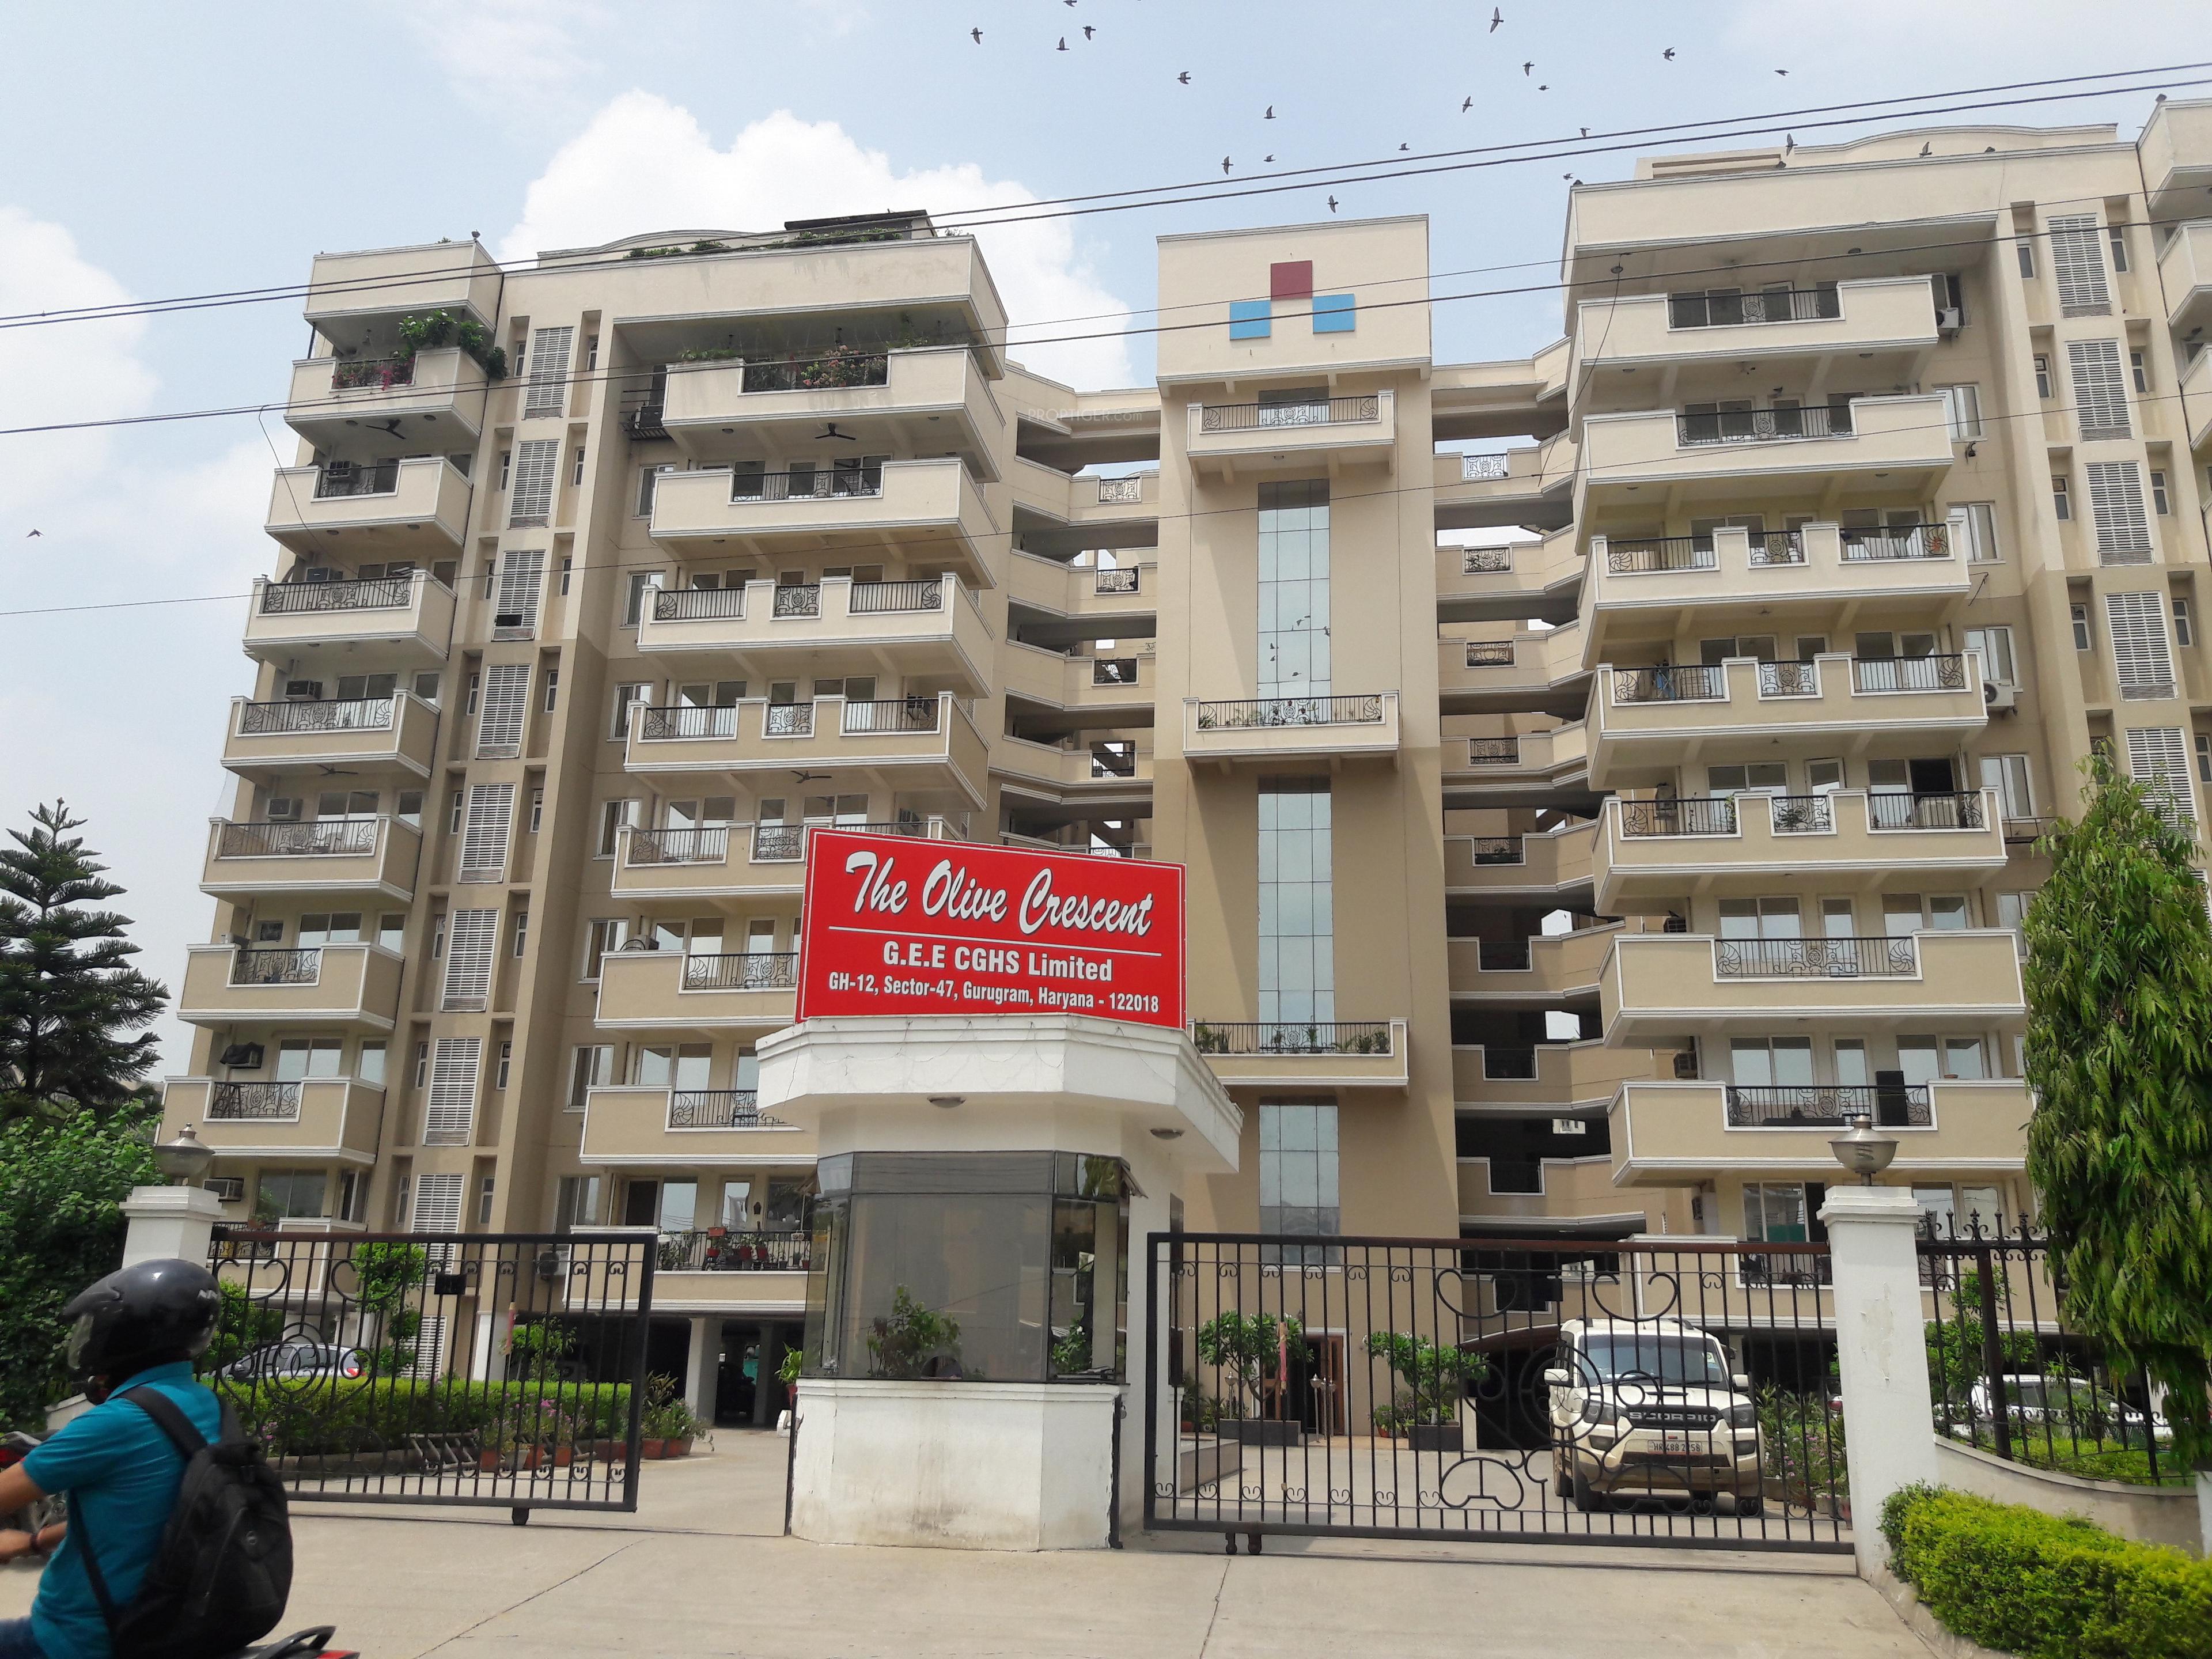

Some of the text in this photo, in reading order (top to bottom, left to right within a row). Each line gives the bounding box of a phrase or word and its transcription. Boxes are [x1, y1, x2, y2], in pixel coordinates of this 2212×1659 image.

[845, 851, 1153, 935] The Olive Crescent
[883, 941, 1113, 982] G.E.E CGHS Limited
[829, 971, 879, 995] GH-12,
[884, 975, 959, 1001] Sector-47,
[963, 981, 1034, 1007] Gurugram,
[1039, 987, 1094, 1010] Haryana
[1109, 992, 1160, 1013] 122018
[1682, 1444, 1700, 1452] 258
